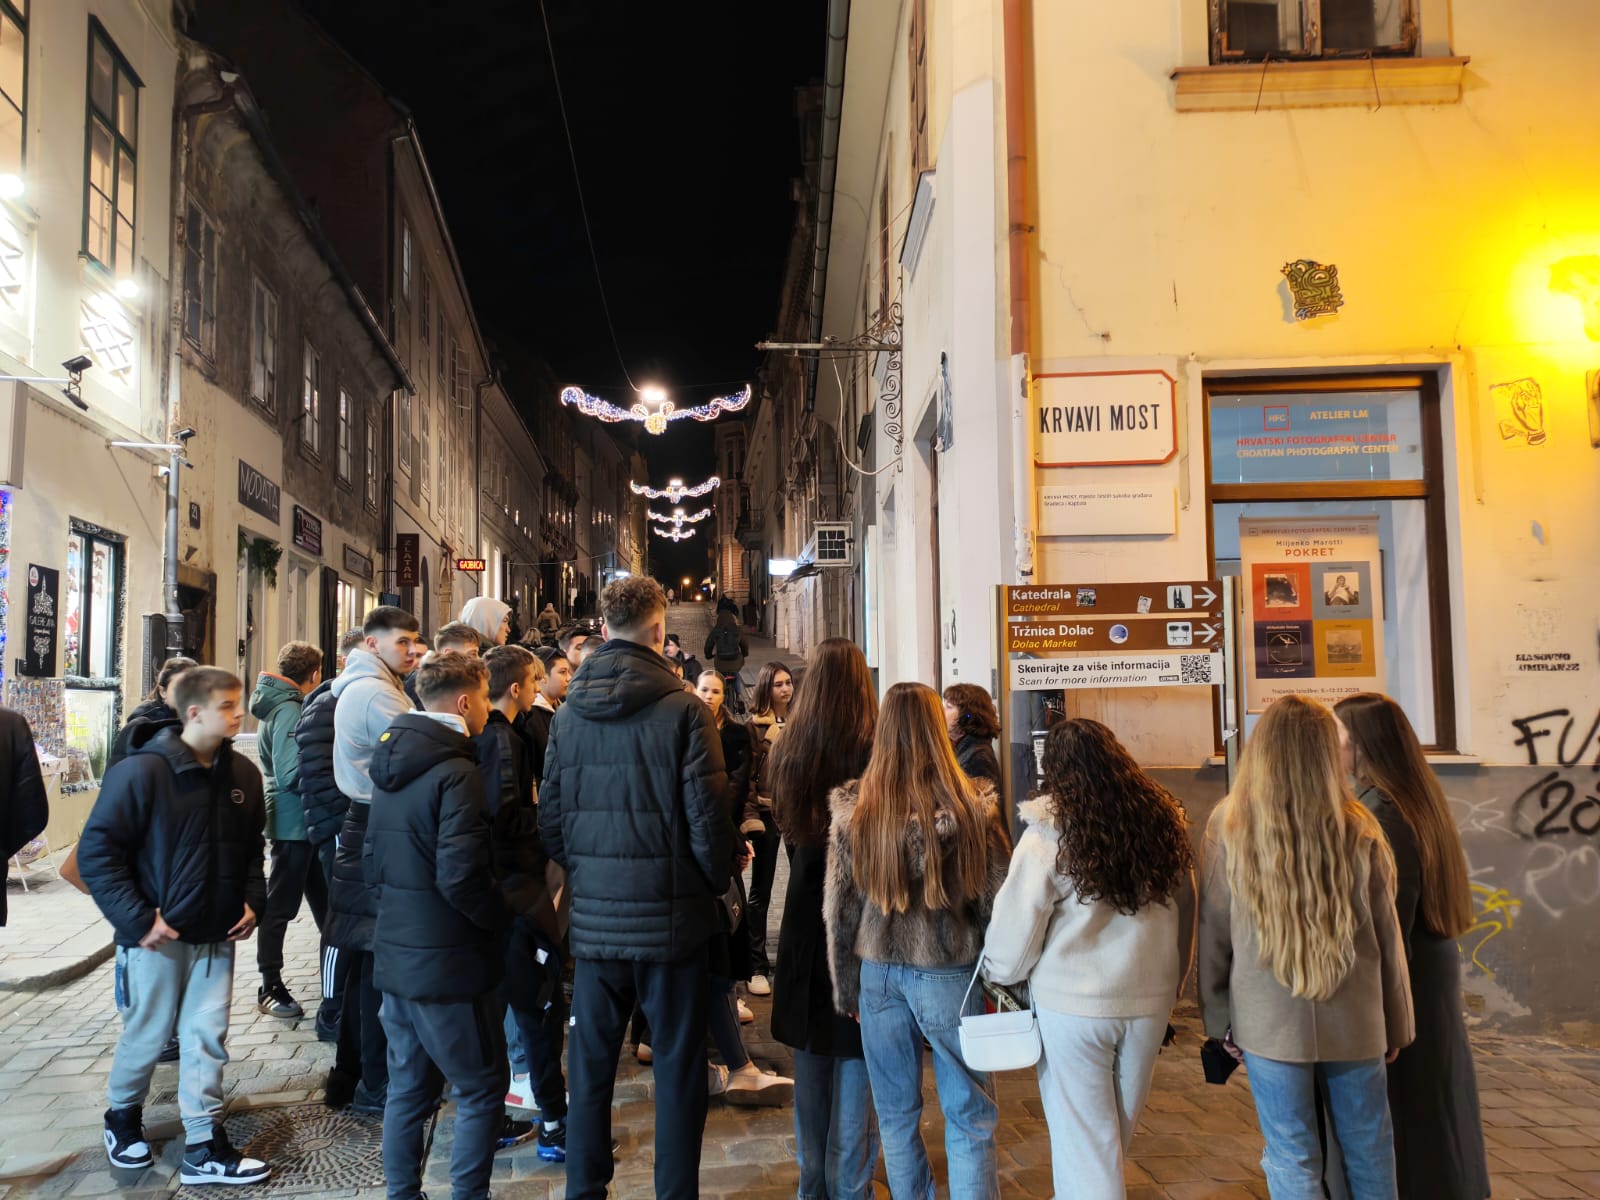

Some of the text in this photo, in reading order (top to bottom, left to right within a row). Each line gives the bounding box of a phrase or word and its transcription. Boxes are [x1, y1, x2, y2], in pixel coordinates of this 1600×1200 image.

[1040, 404, 1160, 433] KRVAVI MOST
[1310, 409, 1368, 420] ATELIER LM
[1237, 434, 1397, 446] HRVATSKI FOTOGRAFSKI CENTAR
[1237, 445, 1399, 458] CROATIAN PHOTOGRAPHY CENTER
[1285, 547, 1335, 557] POKRET
[403, 540, 412, 579] ZLATAR
[1012, 588, 1071, 600] Katedrala
[1013, 602, 1060, 612] Cathedral
[1012, 624, 1094, 637] Tržnica Dolac
[1012, 639, 1077, 649] Dolac Market
[1017, 659, 1170, 674] Skenirajte za više informacija
[1018, 674, 1147, 686] Scan for more information
